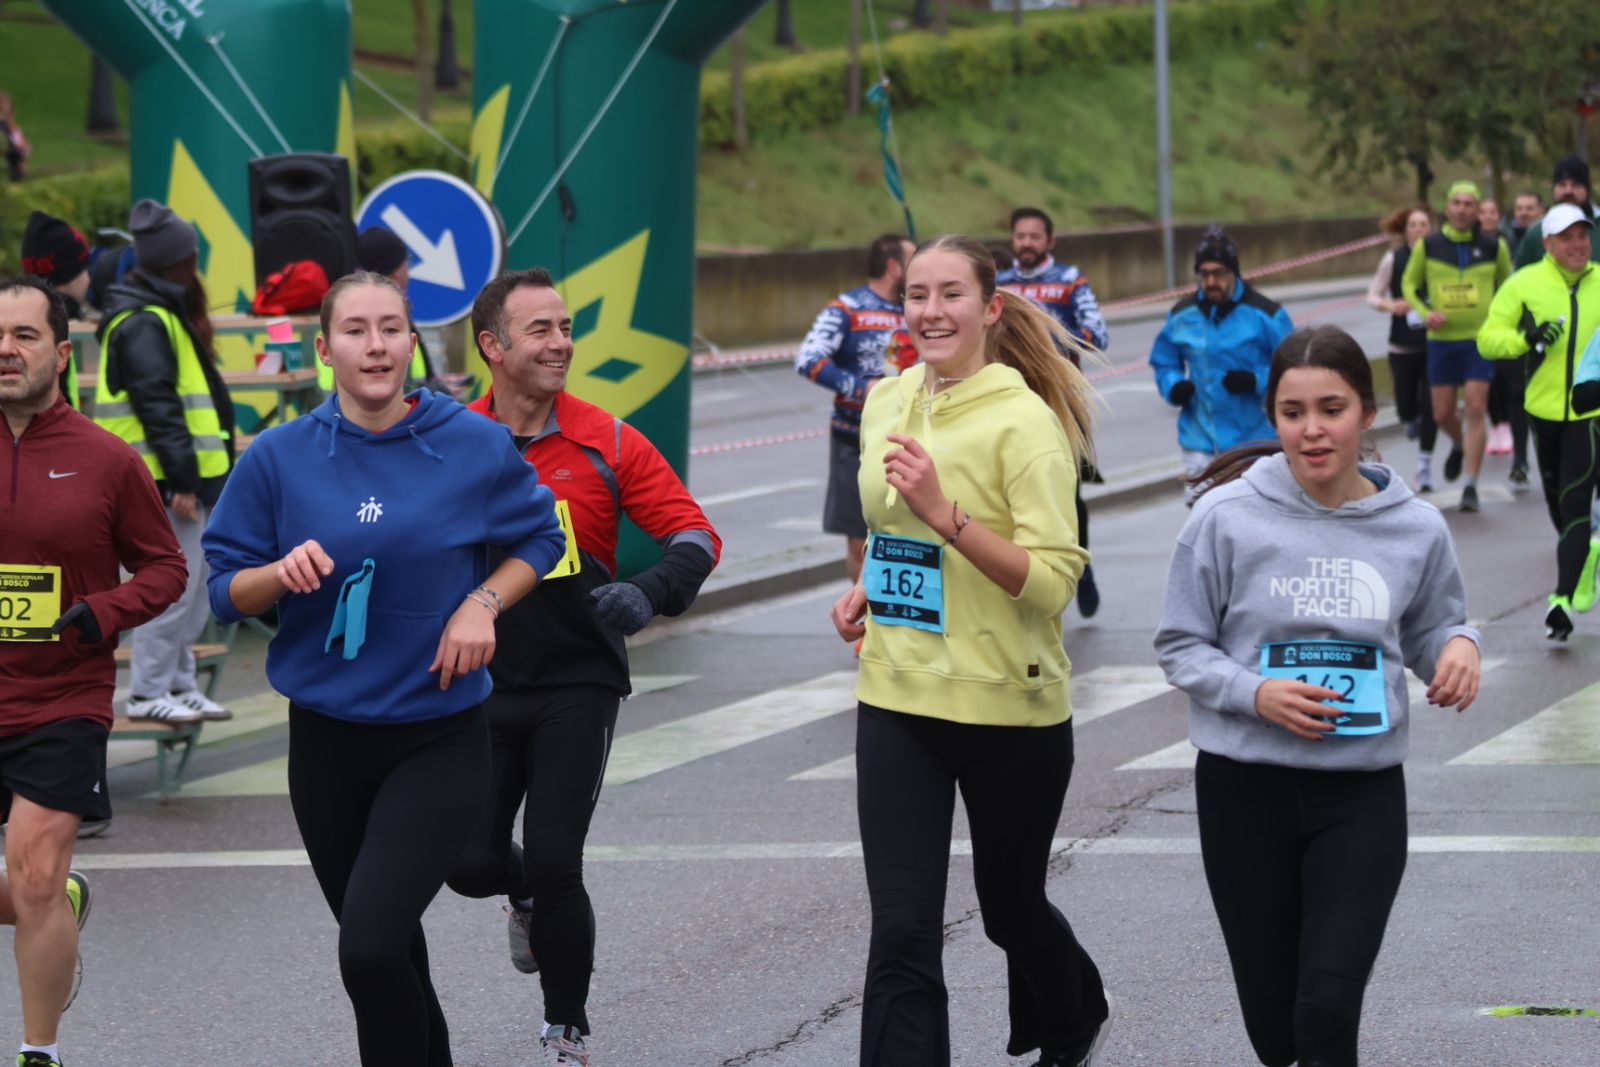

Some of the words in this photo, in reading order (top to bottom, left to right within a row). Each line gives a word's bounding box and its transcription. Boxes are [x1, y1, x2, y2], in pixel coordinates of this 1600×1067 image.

[885, 546, 904, 557] DON
[904, 548, 924, 560] BOSCO
[1307, 556, 1351, 577] THE
[3, 579, 29, 587] BOSCO
[881, 568, 924, 600] 162
[1269, 576, 1351, 598] NORTH
[1293, 597, 1349, 618] FACE
[1299, 652, 1321, 661] DON
[1322, 652, 1353, 662] BOSCO
